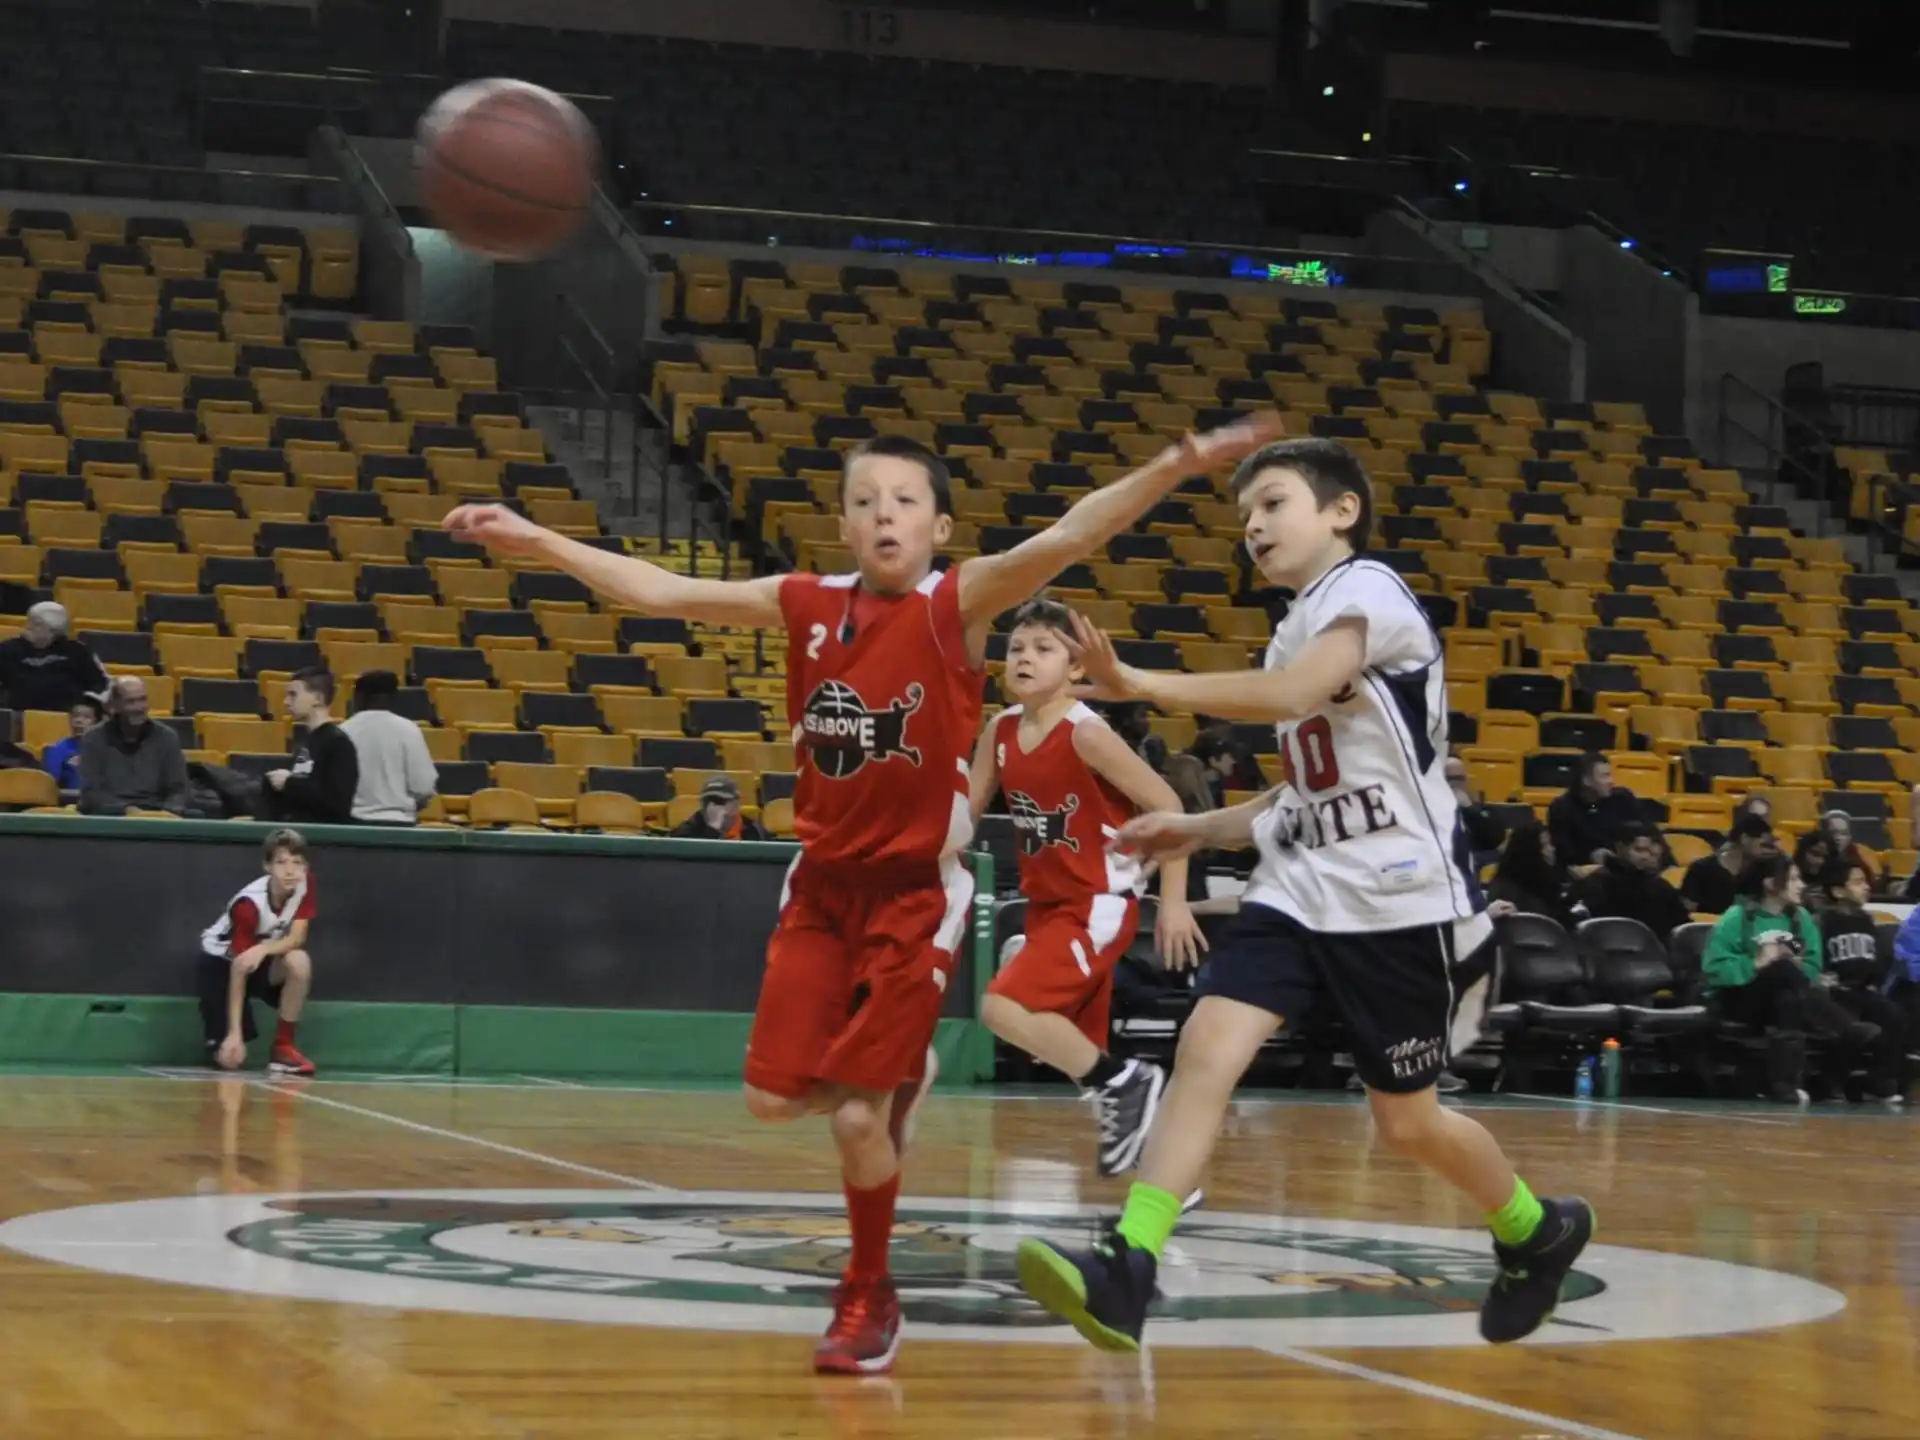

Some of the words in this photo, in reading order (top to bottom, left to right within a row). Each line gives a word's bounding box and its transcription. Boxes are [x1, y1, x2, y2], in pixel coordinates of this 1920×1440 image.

[842, 10, 899, 44] 113
[806, 623, 827, 660] 2
[1274, 783, 1398, 852] ITE
